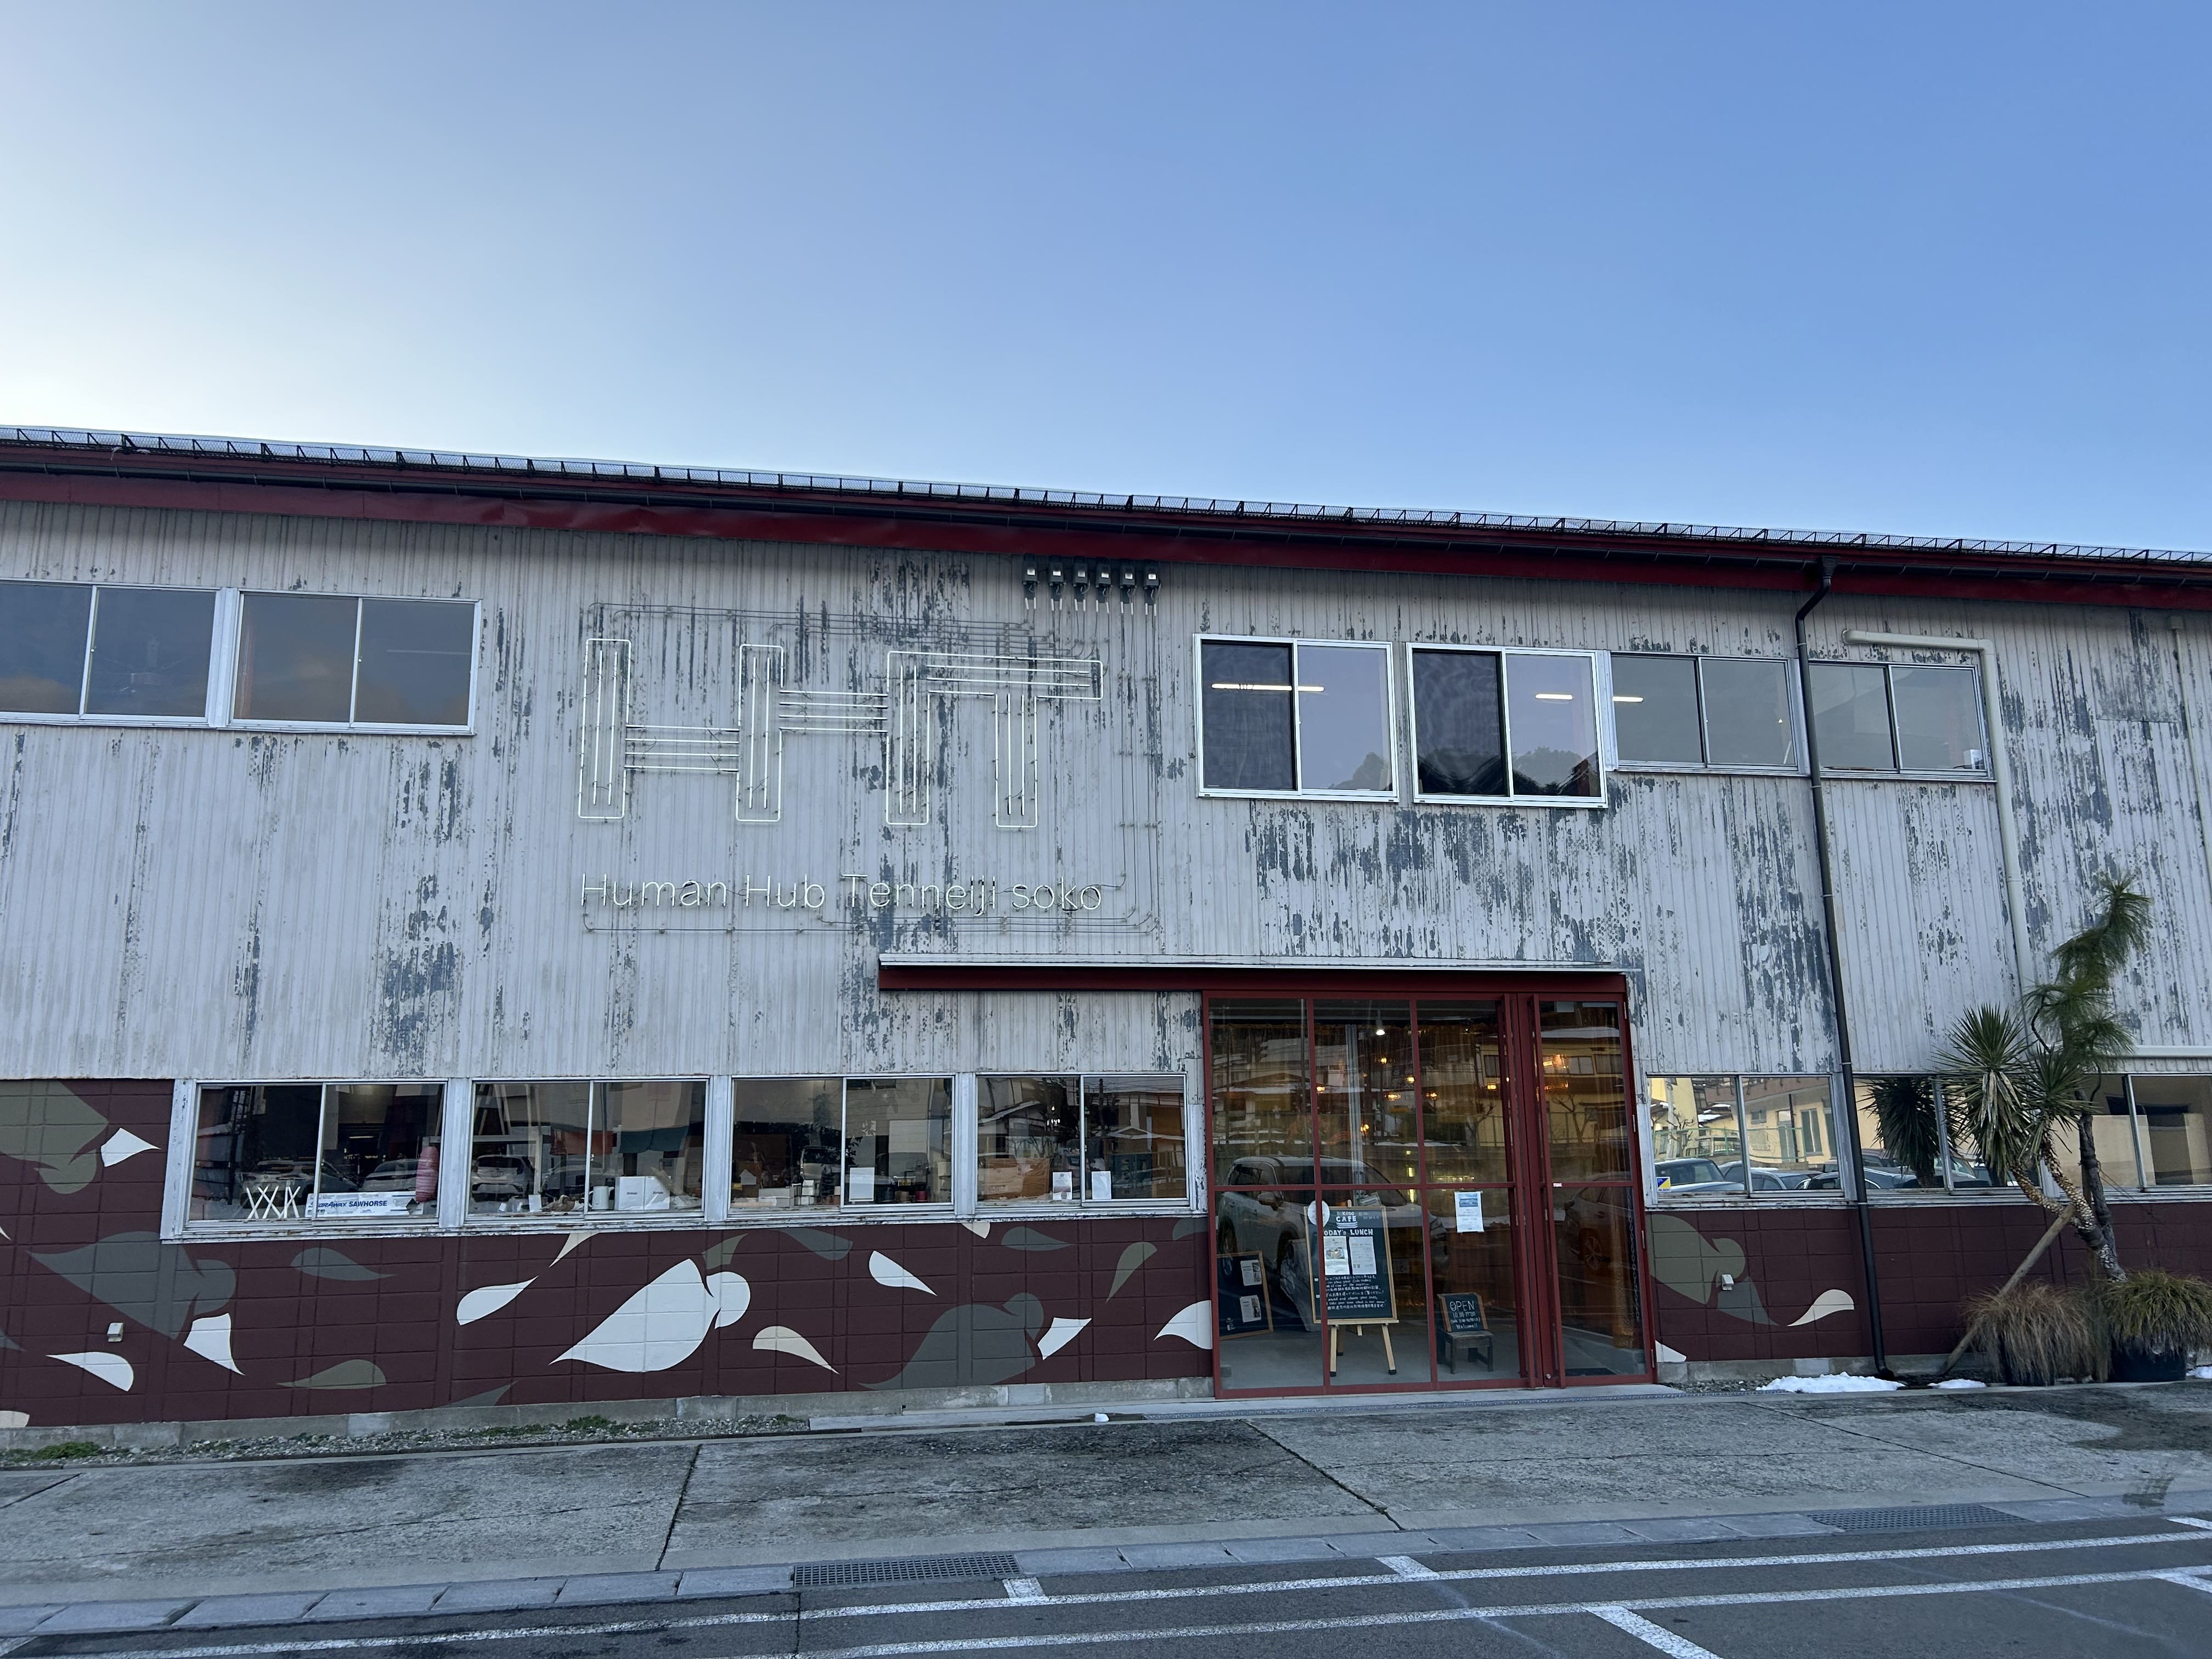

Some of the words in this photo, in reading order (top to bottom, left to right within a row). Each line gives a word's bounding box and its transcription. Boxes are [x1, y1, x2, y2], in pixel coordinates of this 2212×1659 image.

[581, 873, 727, 907] Human
[746, 873, 825, 908] Hub
[841, 874, 996, 917] Tenneiji
[1012, 876, 1102, 911] soko
[1449, 1300, 1475, 1311] OPEN
